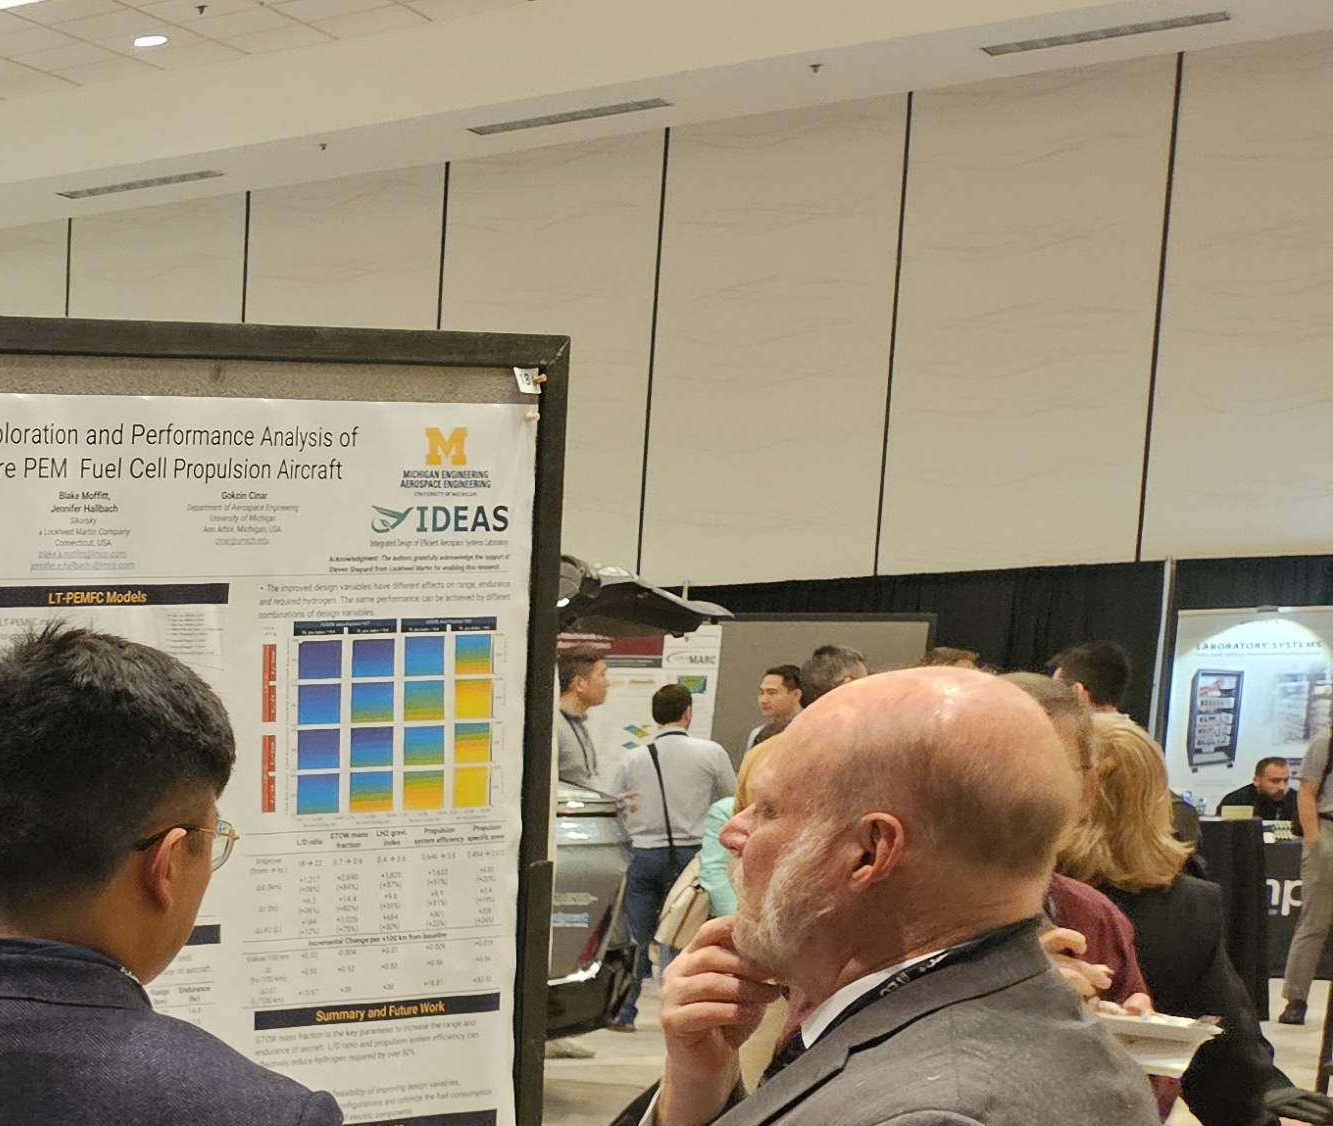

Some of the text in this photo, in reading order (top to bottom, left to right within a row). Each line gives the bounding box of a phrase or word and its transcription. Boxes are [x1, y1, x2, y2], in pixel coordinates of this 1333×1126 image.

[519, 373, 531, 386] 18
[85, 422, 123, 445] and
[131, 422, 254, 446] Performance
[260, 425, 332, 450] Analysis
[339, 425, 358, 447] of
[23, 457, 66, 478] PEM
[80, 456, 121, 478] Fuel
[129, 456, 166, 478] Cell
[173, 457, 270, 484] Propulsion
[276, 458, 342, 479] Aircraft
[403, 470, 488, 480] MICHIGAN ENGINEERING
[400, 479, 490, 488] AEROSPACE ENGINEERING
[58, 491, 79, 500] Blake
[50, 503, 118, 512] Jennifer Hallbach
[416, 505, 511, 533] IDEAS
[48, 590, 148, 606] LT-PEMFC Models
[316, 1001, 444, 1021] Summary and Future Work
